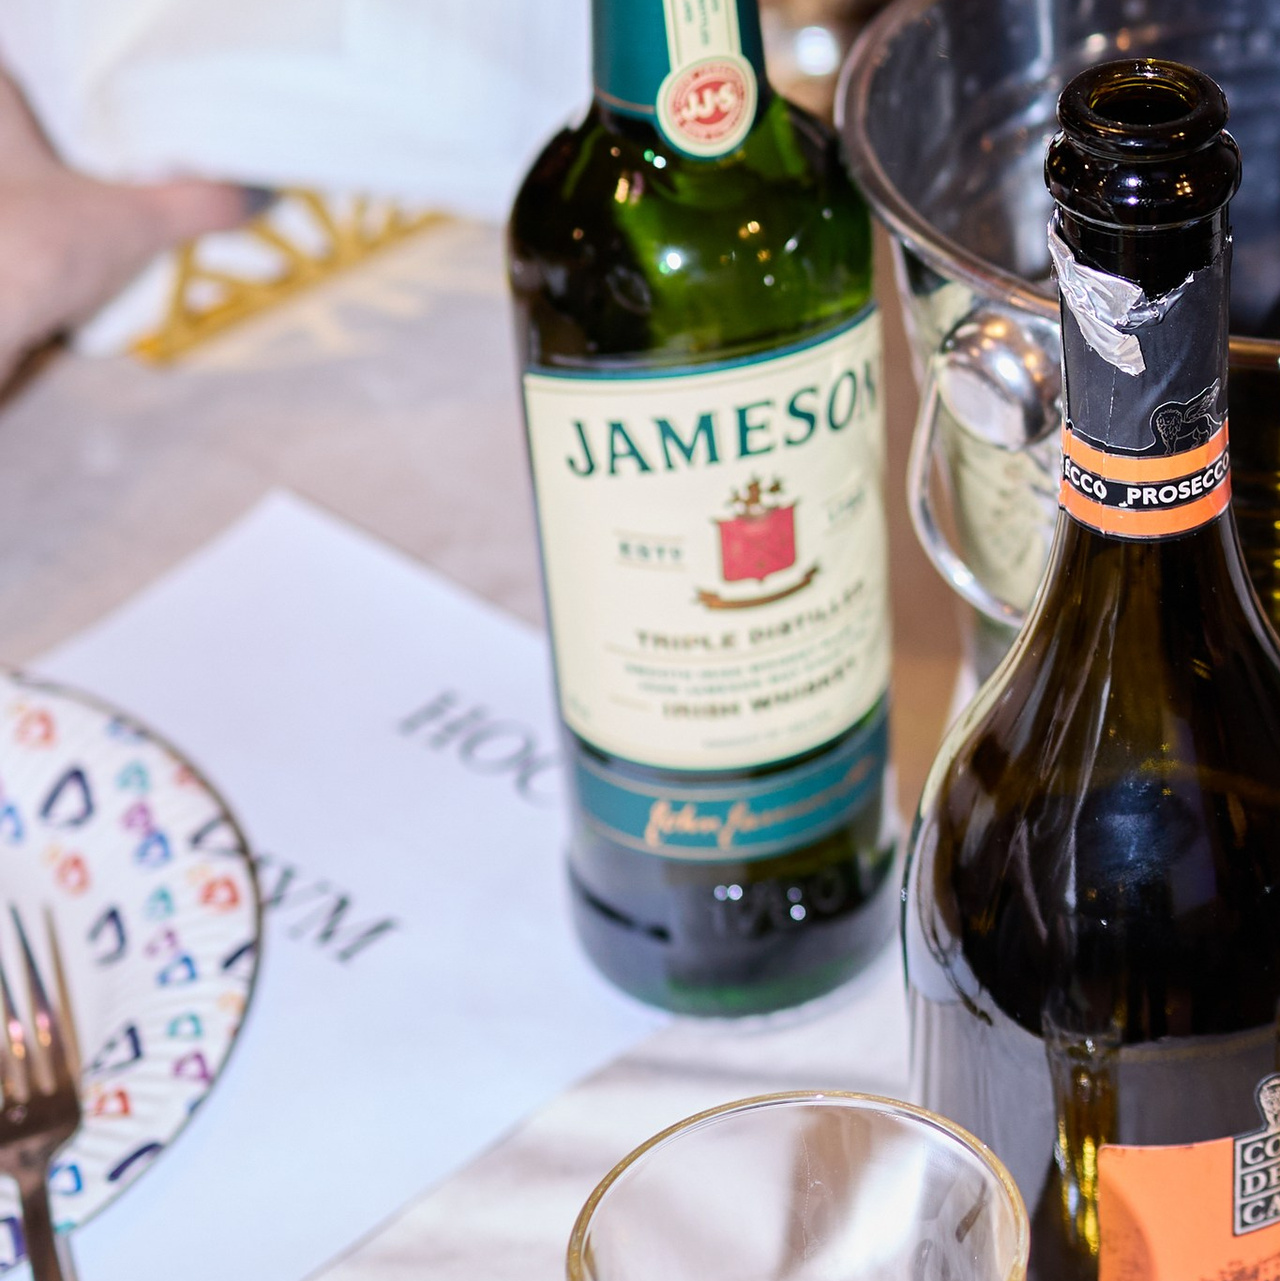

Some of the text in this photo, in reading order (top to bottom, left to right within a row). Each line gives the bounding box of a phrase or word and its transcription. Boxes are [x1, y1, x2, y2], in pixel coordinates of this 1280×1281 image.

[1126, 452, 1229, 506] PROSECCO
[636, 629, 736, 650] TRIPLE
[662, 698, 741, 718] IRISH
